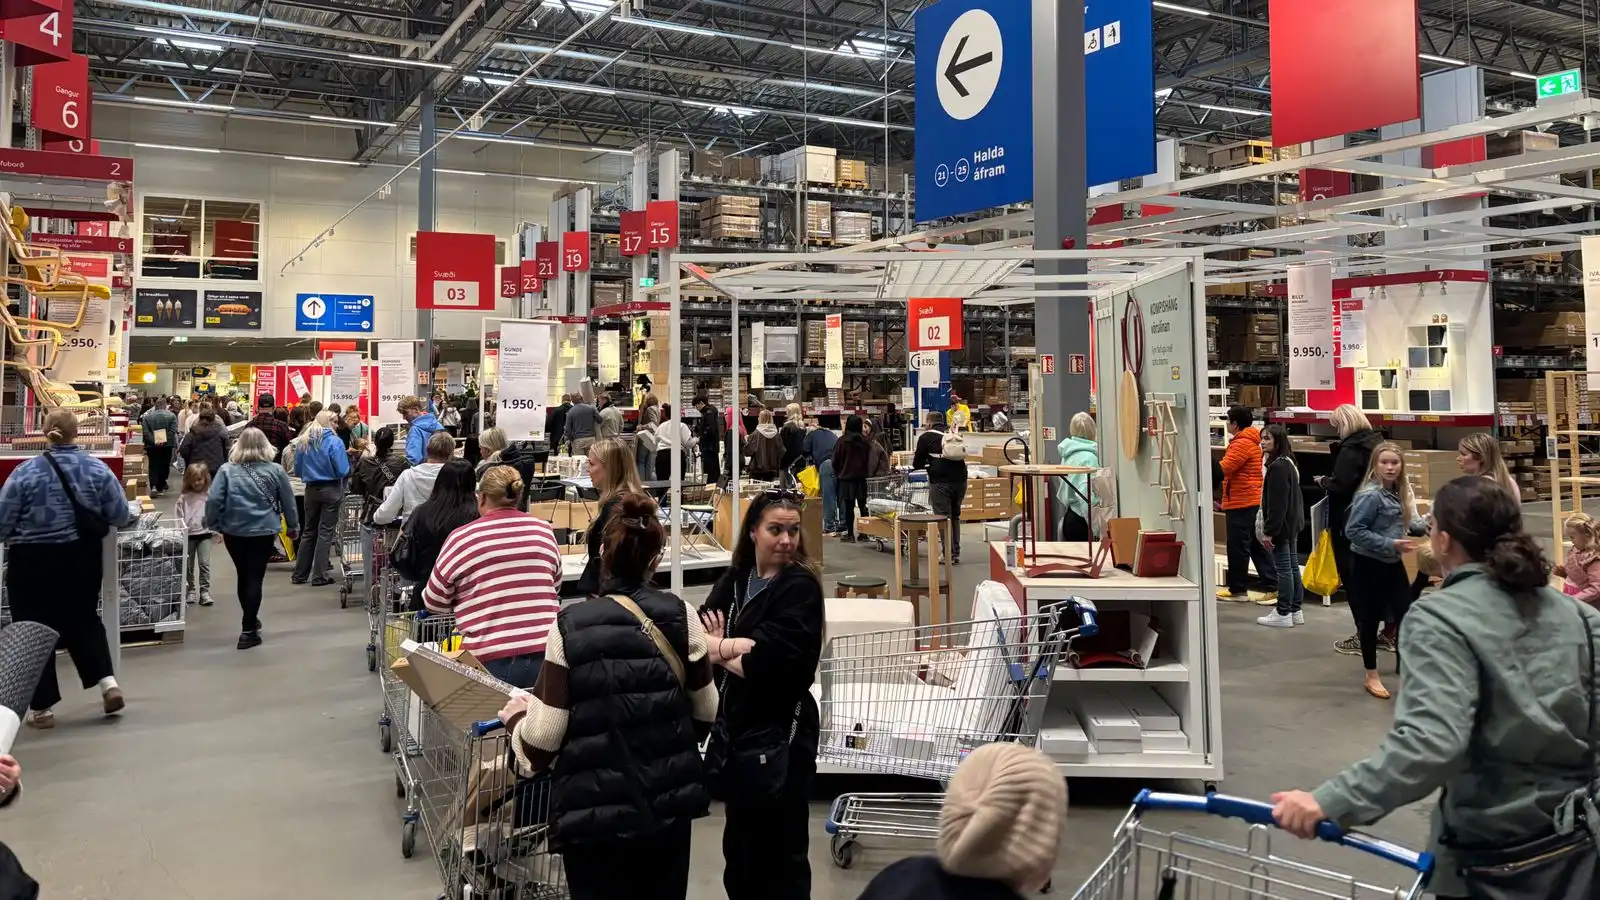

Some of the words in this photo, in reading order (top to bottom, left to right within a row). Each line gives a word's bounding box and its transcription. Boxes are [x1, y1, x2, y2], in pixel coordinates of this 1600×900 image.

[39, 12, 62, 46] 4
[55, 86, 79, 97] Gangur
[62, 101, 79, 129] 6
[974, 147, 1004, 163] Halda
[110, 163, 121, 176] 2
[938, 172, 946, 180] 21
[958, 167, 967, 175] 25
[974, 165, 1005, 181] áfram
[650, 228, 670, 244] 15
[118, 241, 125, 250] 6
[624, 236, 642, 251] 17
[566, 253, 582, 268] 19
[433, 270, 456, 278] Svæði
[538, 262, 554, 275] 21
[1438, 271, 1444, 279] 7
[503, 284, 516, 295] 25
[523, 278, 538, 290] 23
[447, 288, 466, 301] 03
[919, 306, 934, 315] Svæði
[928, 325, 940, 340] 02
[1293, 347, 1329, 358] 9.950,-
[501, 399, 542, 411] 1.950,-
